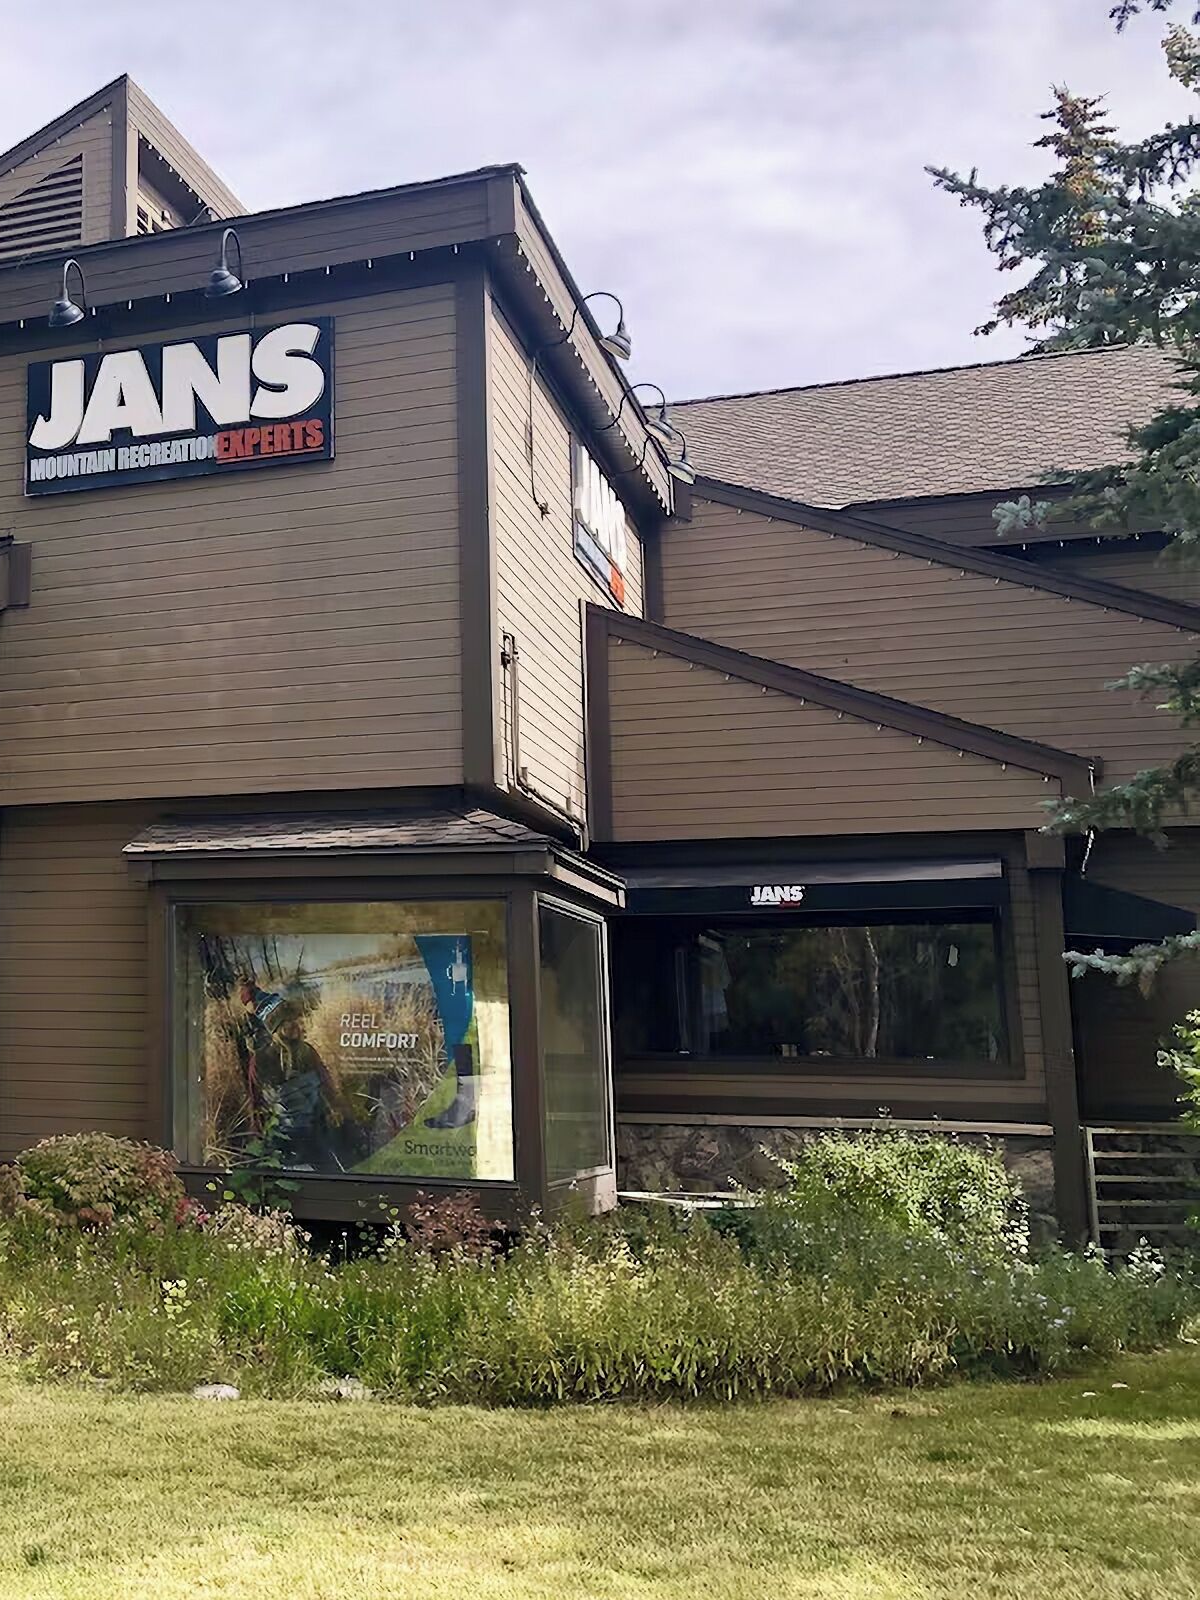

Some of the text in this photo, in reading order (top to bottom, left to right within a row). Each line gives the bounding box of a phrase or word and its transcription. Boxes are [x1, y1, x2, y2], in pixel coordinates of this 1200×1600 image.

[29, 323, 325, 449] JANS
[30, 419, 324, 482] MOUNTAIN RECREATION EXPERTS
[751, 886, 804, 901] JANS
[340, 1013, 380, 1029] REEL
[340, 1033, 419, 1049] COMFORT
